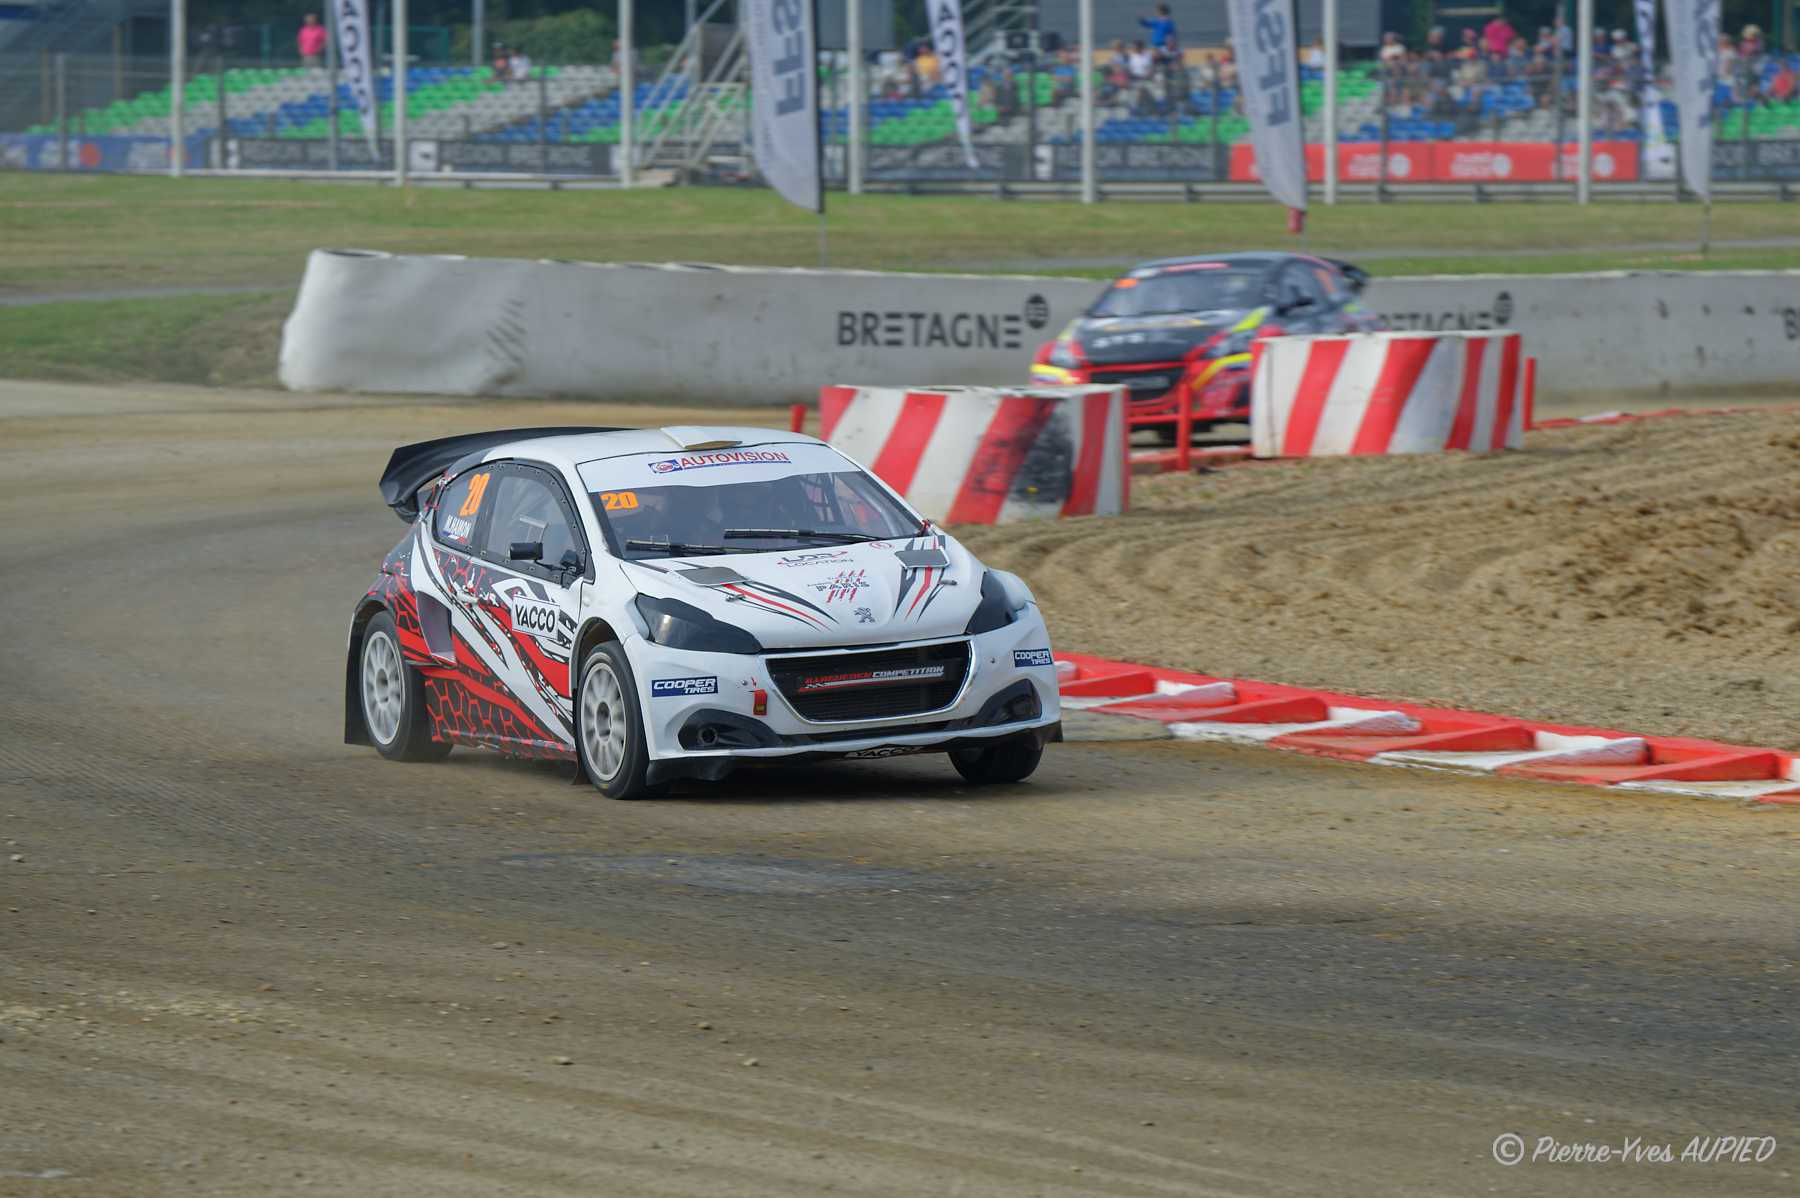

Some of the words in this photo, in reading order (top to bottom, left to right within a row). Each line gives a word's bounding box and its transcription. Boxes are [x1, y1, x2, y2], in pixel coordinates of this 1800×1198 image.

[838, 312, 1021, 349] BRETAGNE
[681, 451, 790, 468] AUTOVISION
[459, 473, 491, 517] 20
[600, 491, 639, 511] 20
[515, 604, 556, 633] YACCO
[1014, 650, 1049, 660] COOPER
[653, 678, 716, 689] COOPER
[684, 686, 715, 694] TIRES
